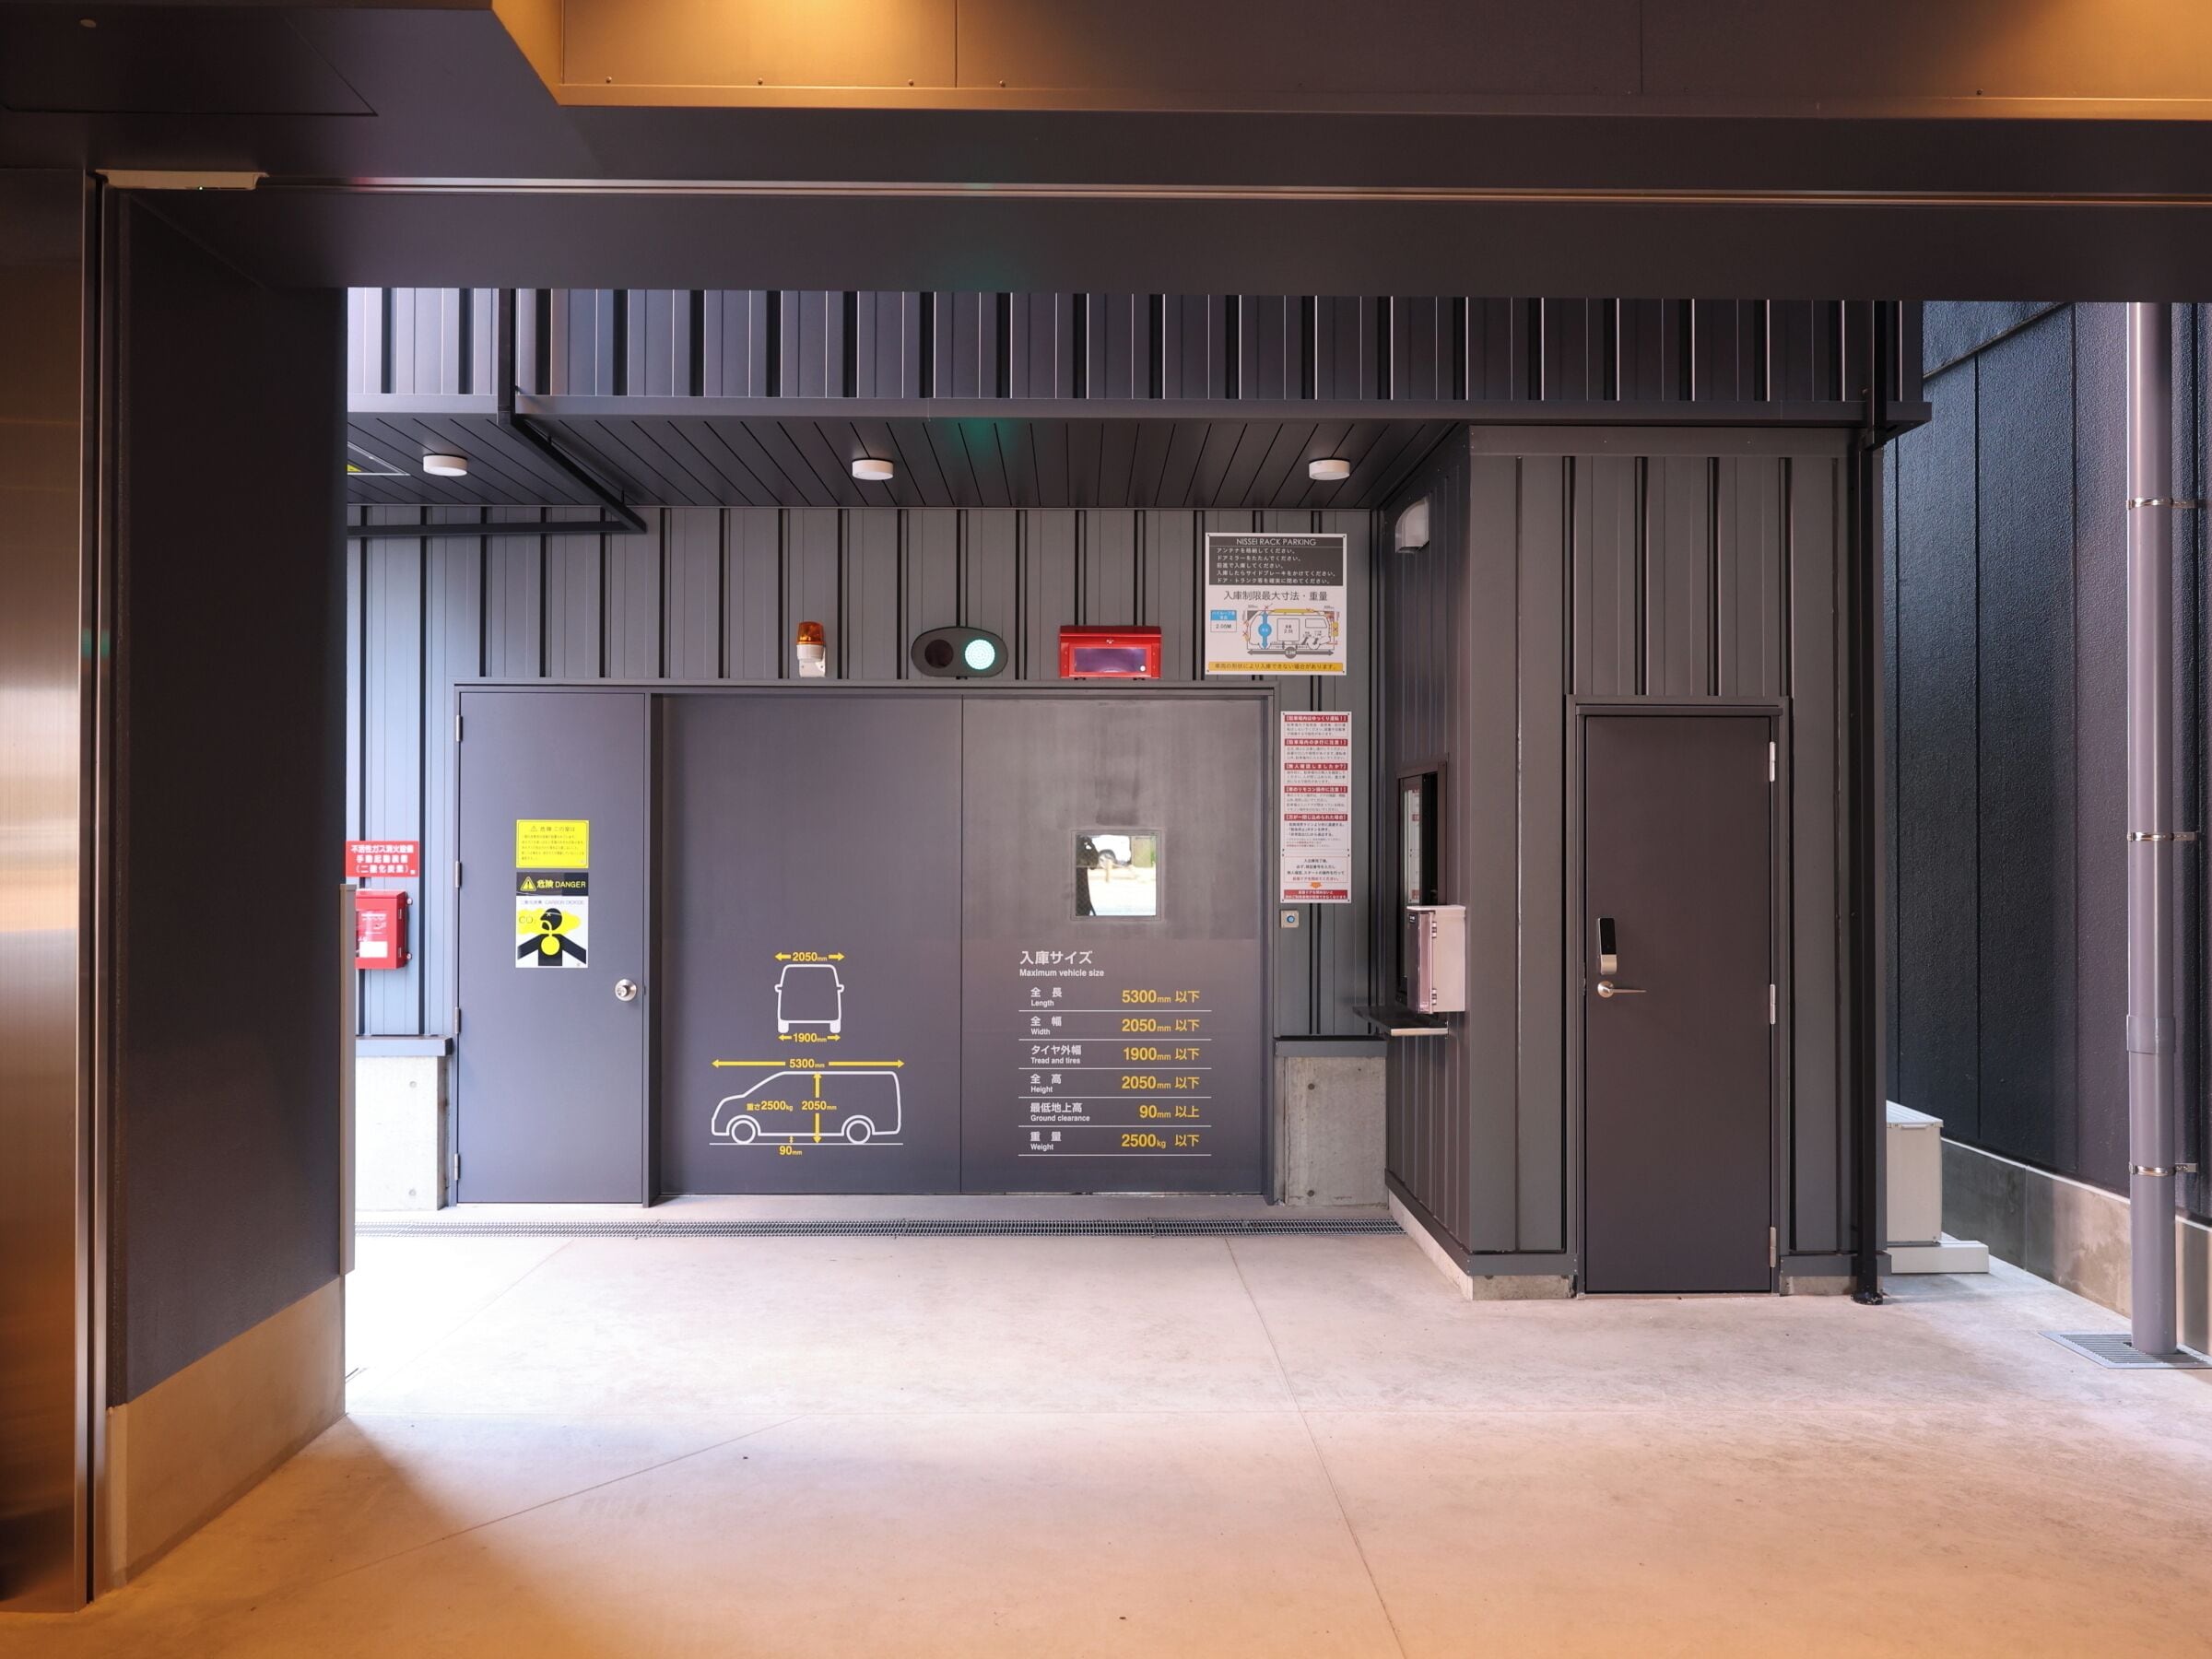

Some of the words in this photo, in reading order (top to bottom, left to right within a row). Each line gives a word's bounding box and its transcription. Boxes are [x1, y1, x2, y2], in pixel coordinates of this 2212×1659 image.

[1223, 591, 1328, 601] 入庫制限最大寸法・重量
[536, 879, 554, 888] 危険
[555, 880, 586, 888] DANGER
[793, 952, 828, 961] 2050mm
[1019, 950, 1093, 965] 入庫サイズ
[1019, 969, 1057, 977] Maximum
[1059, 969, 1087, 977] vehicle
[1088, 969, 1104, 977] size
[1122, 989, 1171, 1004] 5300mm
[1175, 990, 1200, 1003] 以下
[1030, 999, 1054, 1007] Length
[1122, 1018, 1171, 1032] 2050mm
[1175, 1018, 1200, 1032] 以下
[1030, 1028, 1051, 1036] Width
[793, 1033, 828, 1042] 1900mm
[1030, 1044, 1082, 1055] タイヤ外幅
[1123, 1047, 1171, 1061] 1900mm
[1175, 1047, 1200, 1061] 以下
[789, 1059, 825, 1068] 5300mm
[1122, 1076, 1171, 1089] 2050mm
[1175, 1077, 1200, 1089] 以下
[1030, 1086, 1053, 1094] Height
[801, 1100, 837, 1111] 2050mm
[1030, 1102, 1083, 1113] 最低地上高
[1139, 1105, 1171, 1119] 90mm
[1175, 1105, 1200, 1118] 以上
[1121, 1134, 1167, 1149] 2500kg
[1175, 1134, 1200, 1147] 以下
[779, 1146, 803, 1156] 90mm
[1030, 1143, 1054, 1151] Weight
